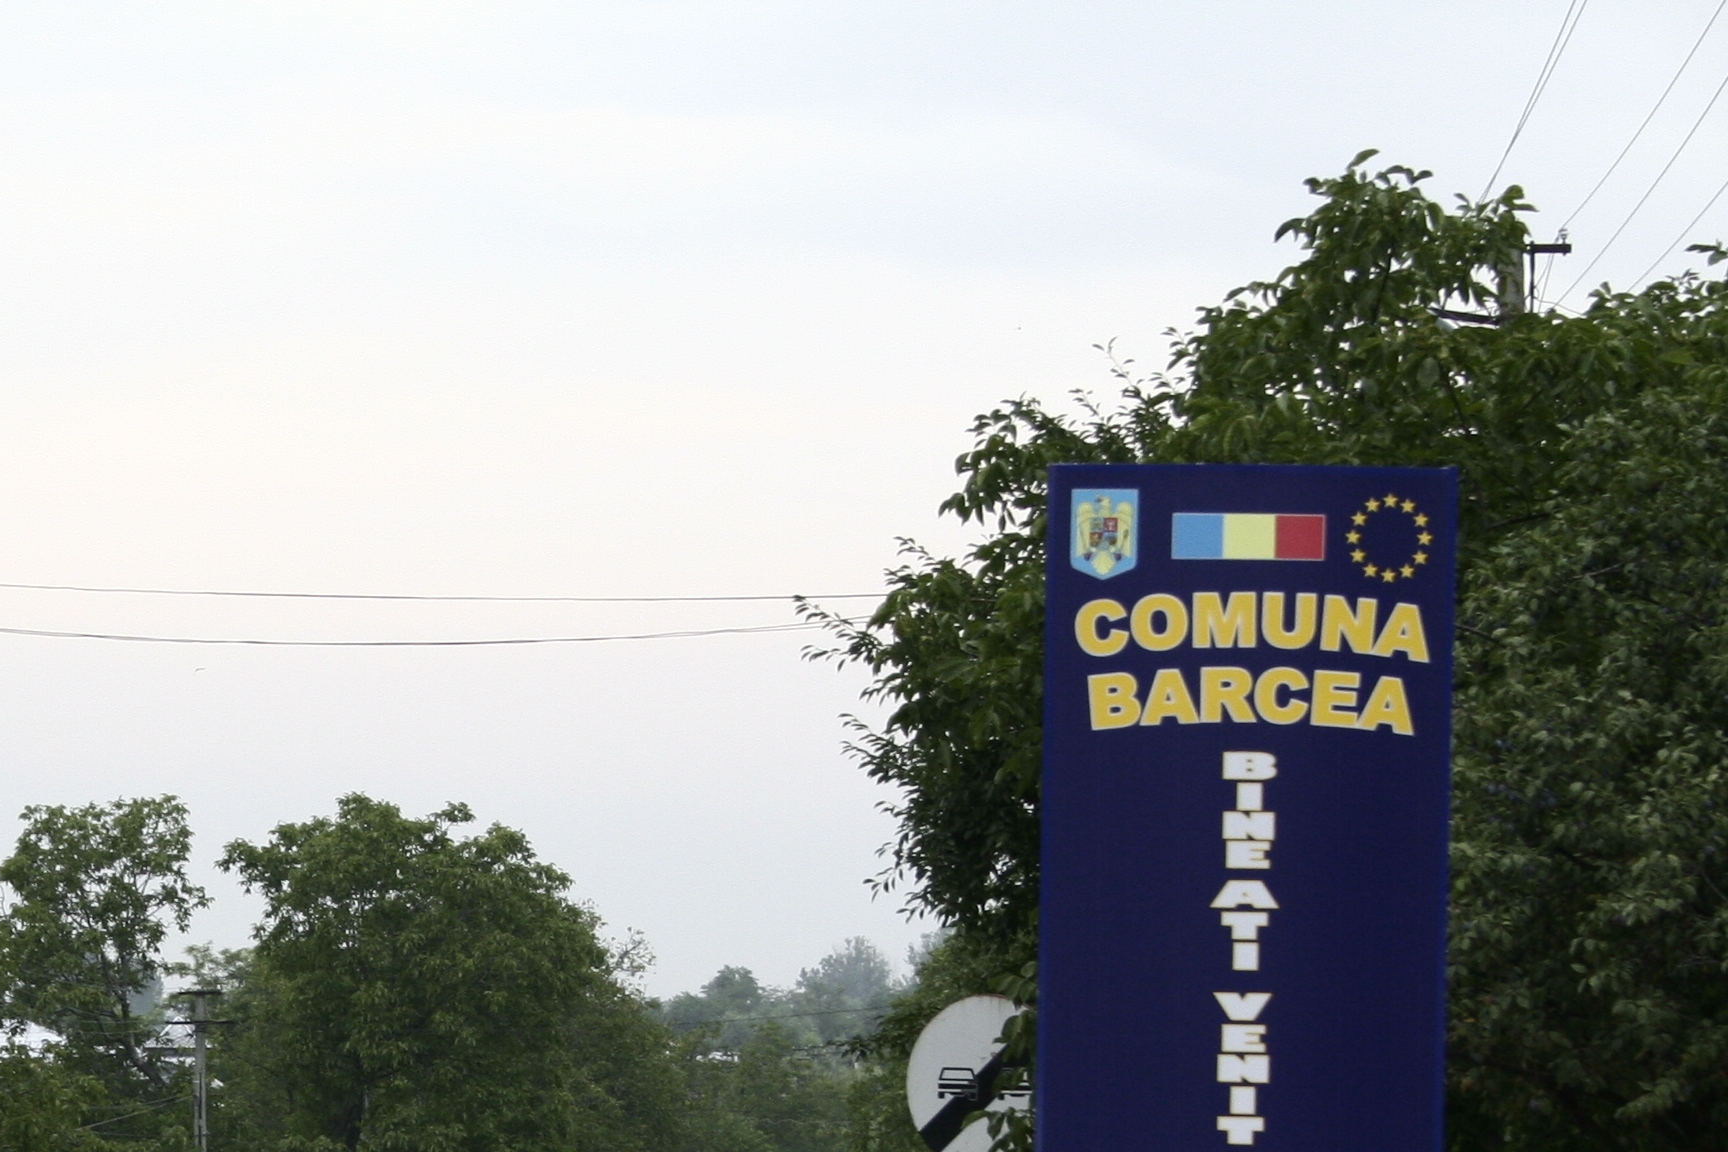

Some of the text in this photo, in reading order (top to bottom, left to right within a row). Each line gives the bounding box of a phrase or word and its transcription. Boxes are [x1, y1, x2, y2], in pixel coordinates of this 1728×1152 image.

[1074, 591, 1430, 663] COMUNA
[1087, 666, 1414, 737] BARCEA
[1209, 751, 1280, 1146] BINE ATI VENIT
